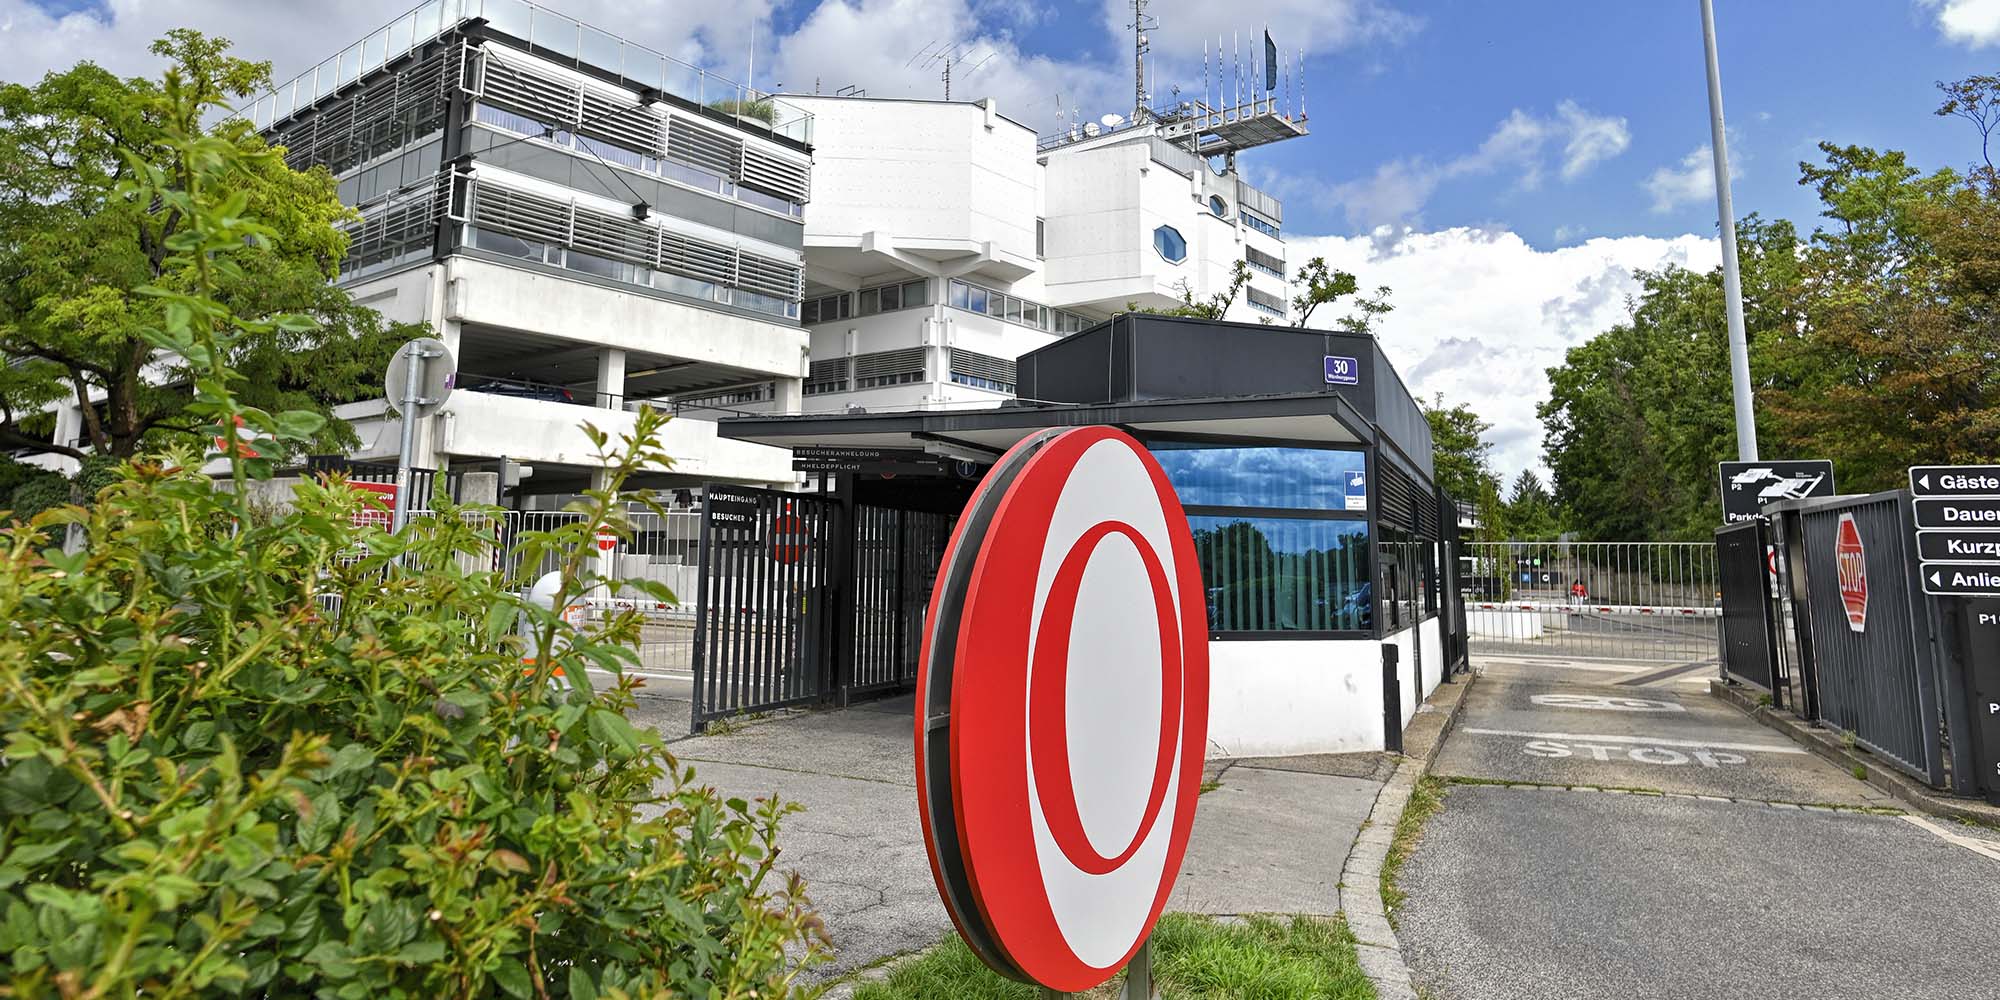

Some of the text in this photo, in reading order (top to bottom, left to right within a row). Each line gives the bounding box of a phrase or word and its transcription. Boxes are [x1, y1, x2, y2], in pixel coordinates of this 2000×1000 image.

[1333, 360, 1348, 374] 30
[1939, 475, 1999, 489] Gäste
[709, 492, 757, 504] HAUPTEINGANG
[712, 512, 745, 522] BESUCHER
[1840, 552, 1863, 592] STOP
[1978, 613, 2000, 625] P1
[1523, 741, 1747, 768] STOP
